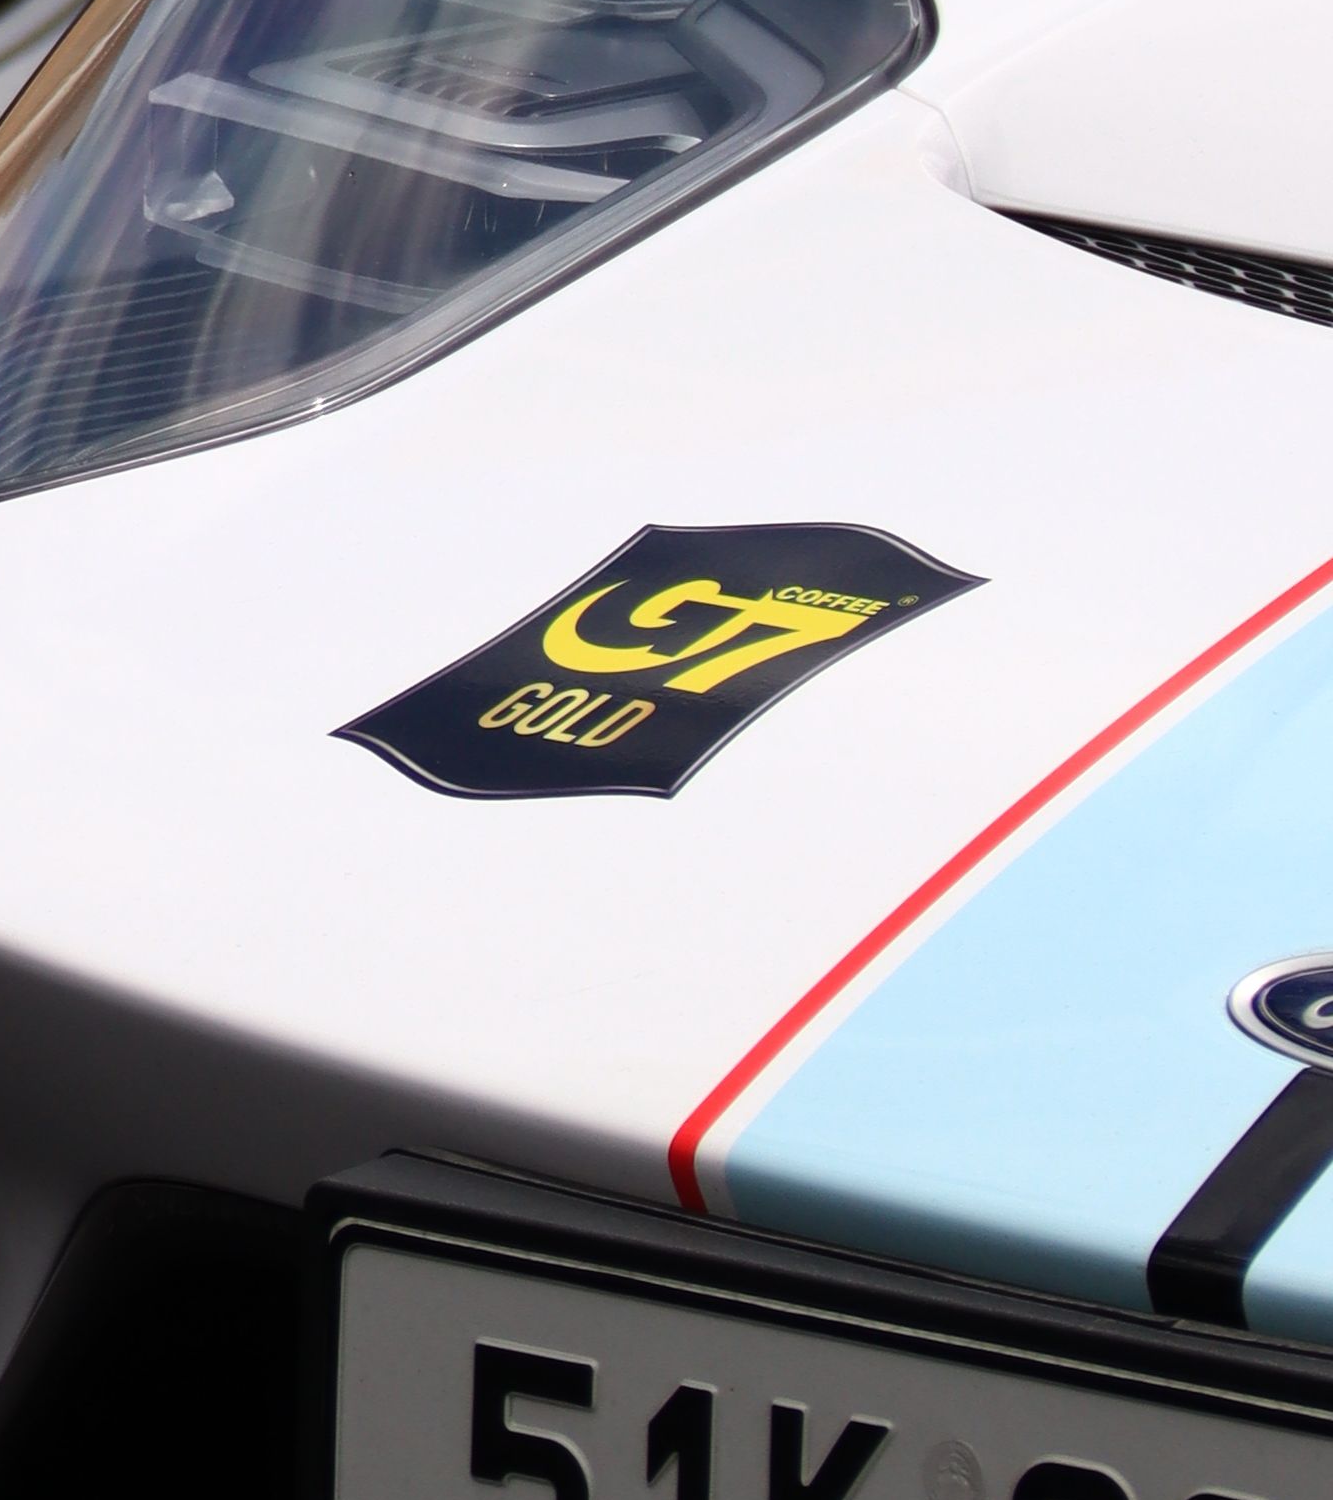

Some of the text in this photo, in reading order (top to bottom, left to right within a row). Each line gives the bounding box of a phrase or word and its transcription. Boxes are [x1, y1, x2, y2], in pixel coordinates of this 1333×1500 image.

[542, 578, 892, 694] G7 COFFEE
[477, 682, 657, 748] GOLD
